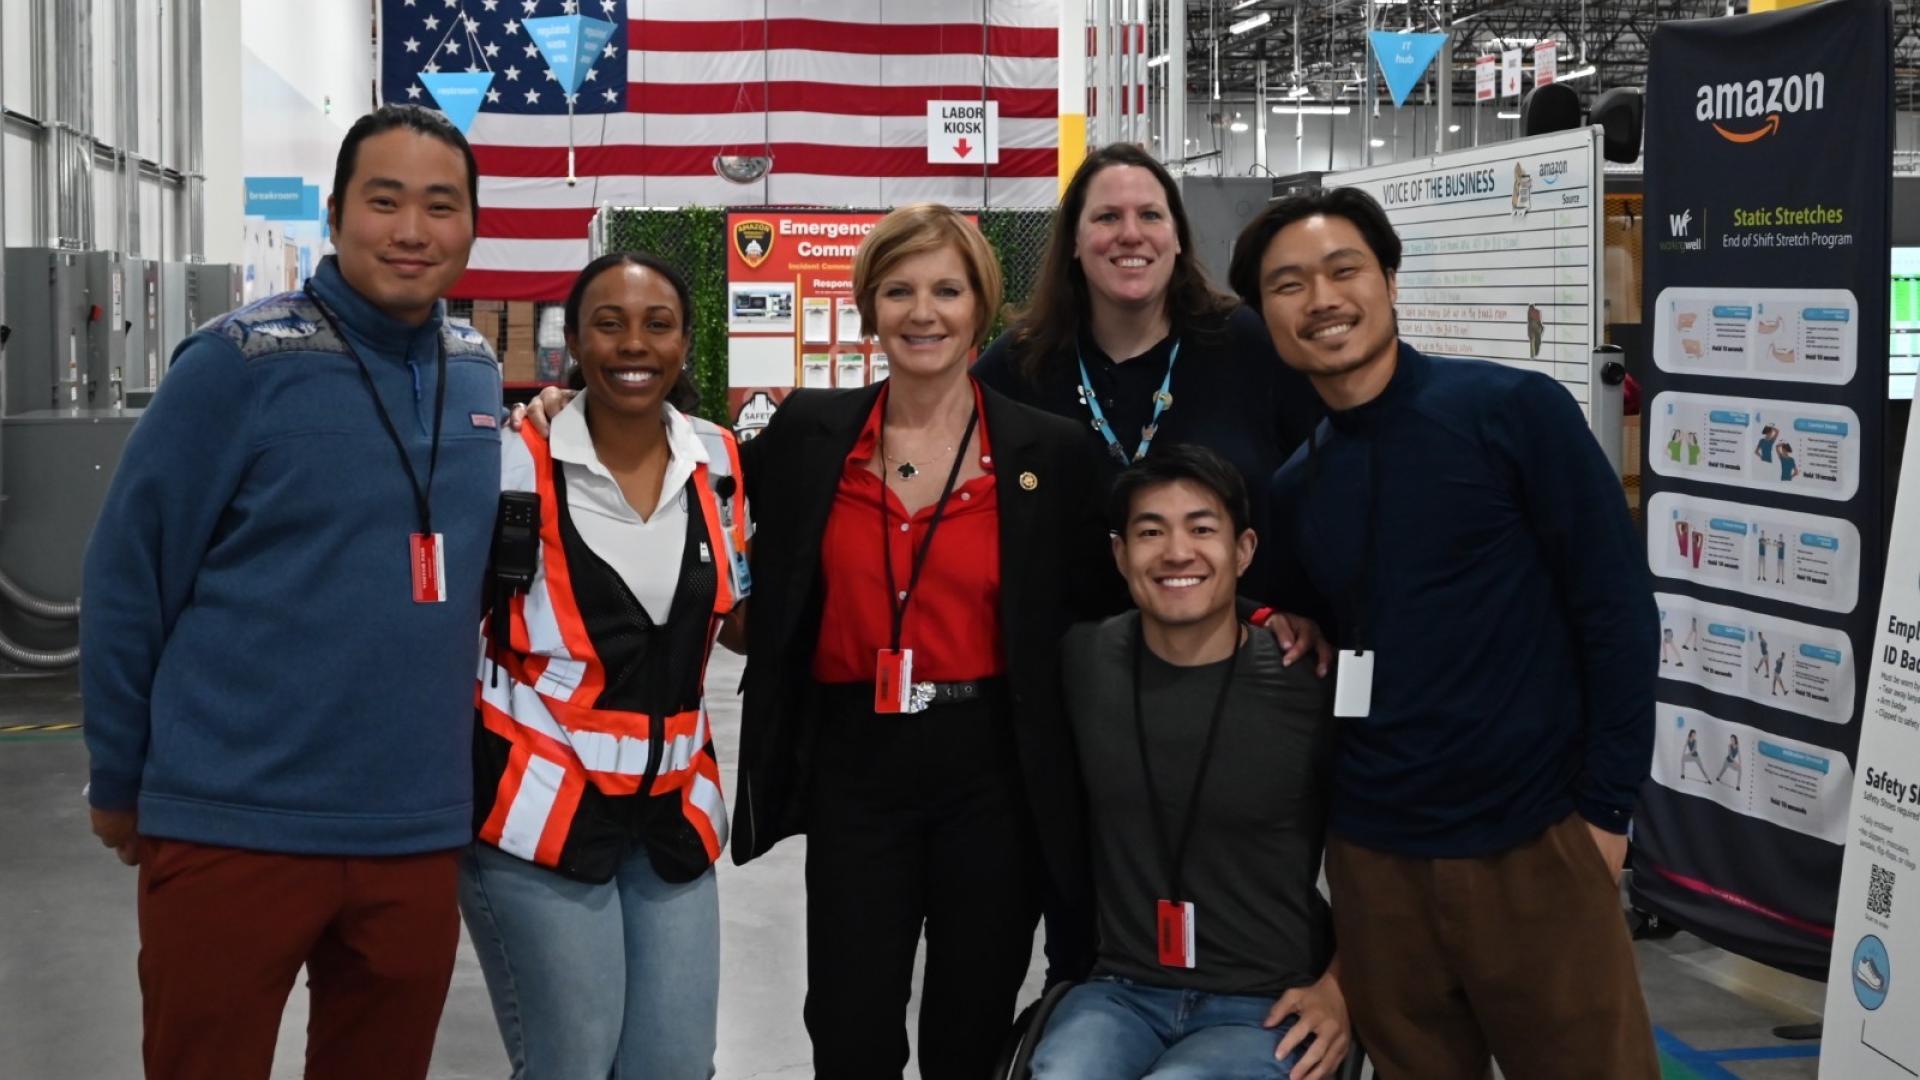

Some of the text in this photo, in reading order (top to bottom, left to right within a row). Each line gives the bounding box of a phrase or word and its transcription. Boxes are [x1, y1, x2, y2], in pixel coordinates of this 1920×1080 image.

[1394, 53, 1415, 64] hub
[1696, 71, 1825, 121] amazon
[942, 106, 985, 119] LABOR
[943, 121, 982, 135] KIOSK
[1538, 159, 1568, 177] amazon
[248, 191, 300, 201] breakroom
[1382, 180, 1409, 206] VOICE
[1410, 179, 1423, 201] OF
[1425, 175, 1443, 199] THE
[1445, 168, 1495, 197] BUSINESS
[1734, 204, 1843, 227] Static Stretches
[738, 223, 770, 232] AMAZON
[779, 219, 876, 239] Emergenc
[797, 241, 859, 257] Comm
[1722, 231, 1853, 249] End of Shift Stretch Program
[1883, 644, 1897, 665] ID
[1865, 766, 1907, 803] Safety
[1863, 790, 1920, 822] Safety Shoes required
